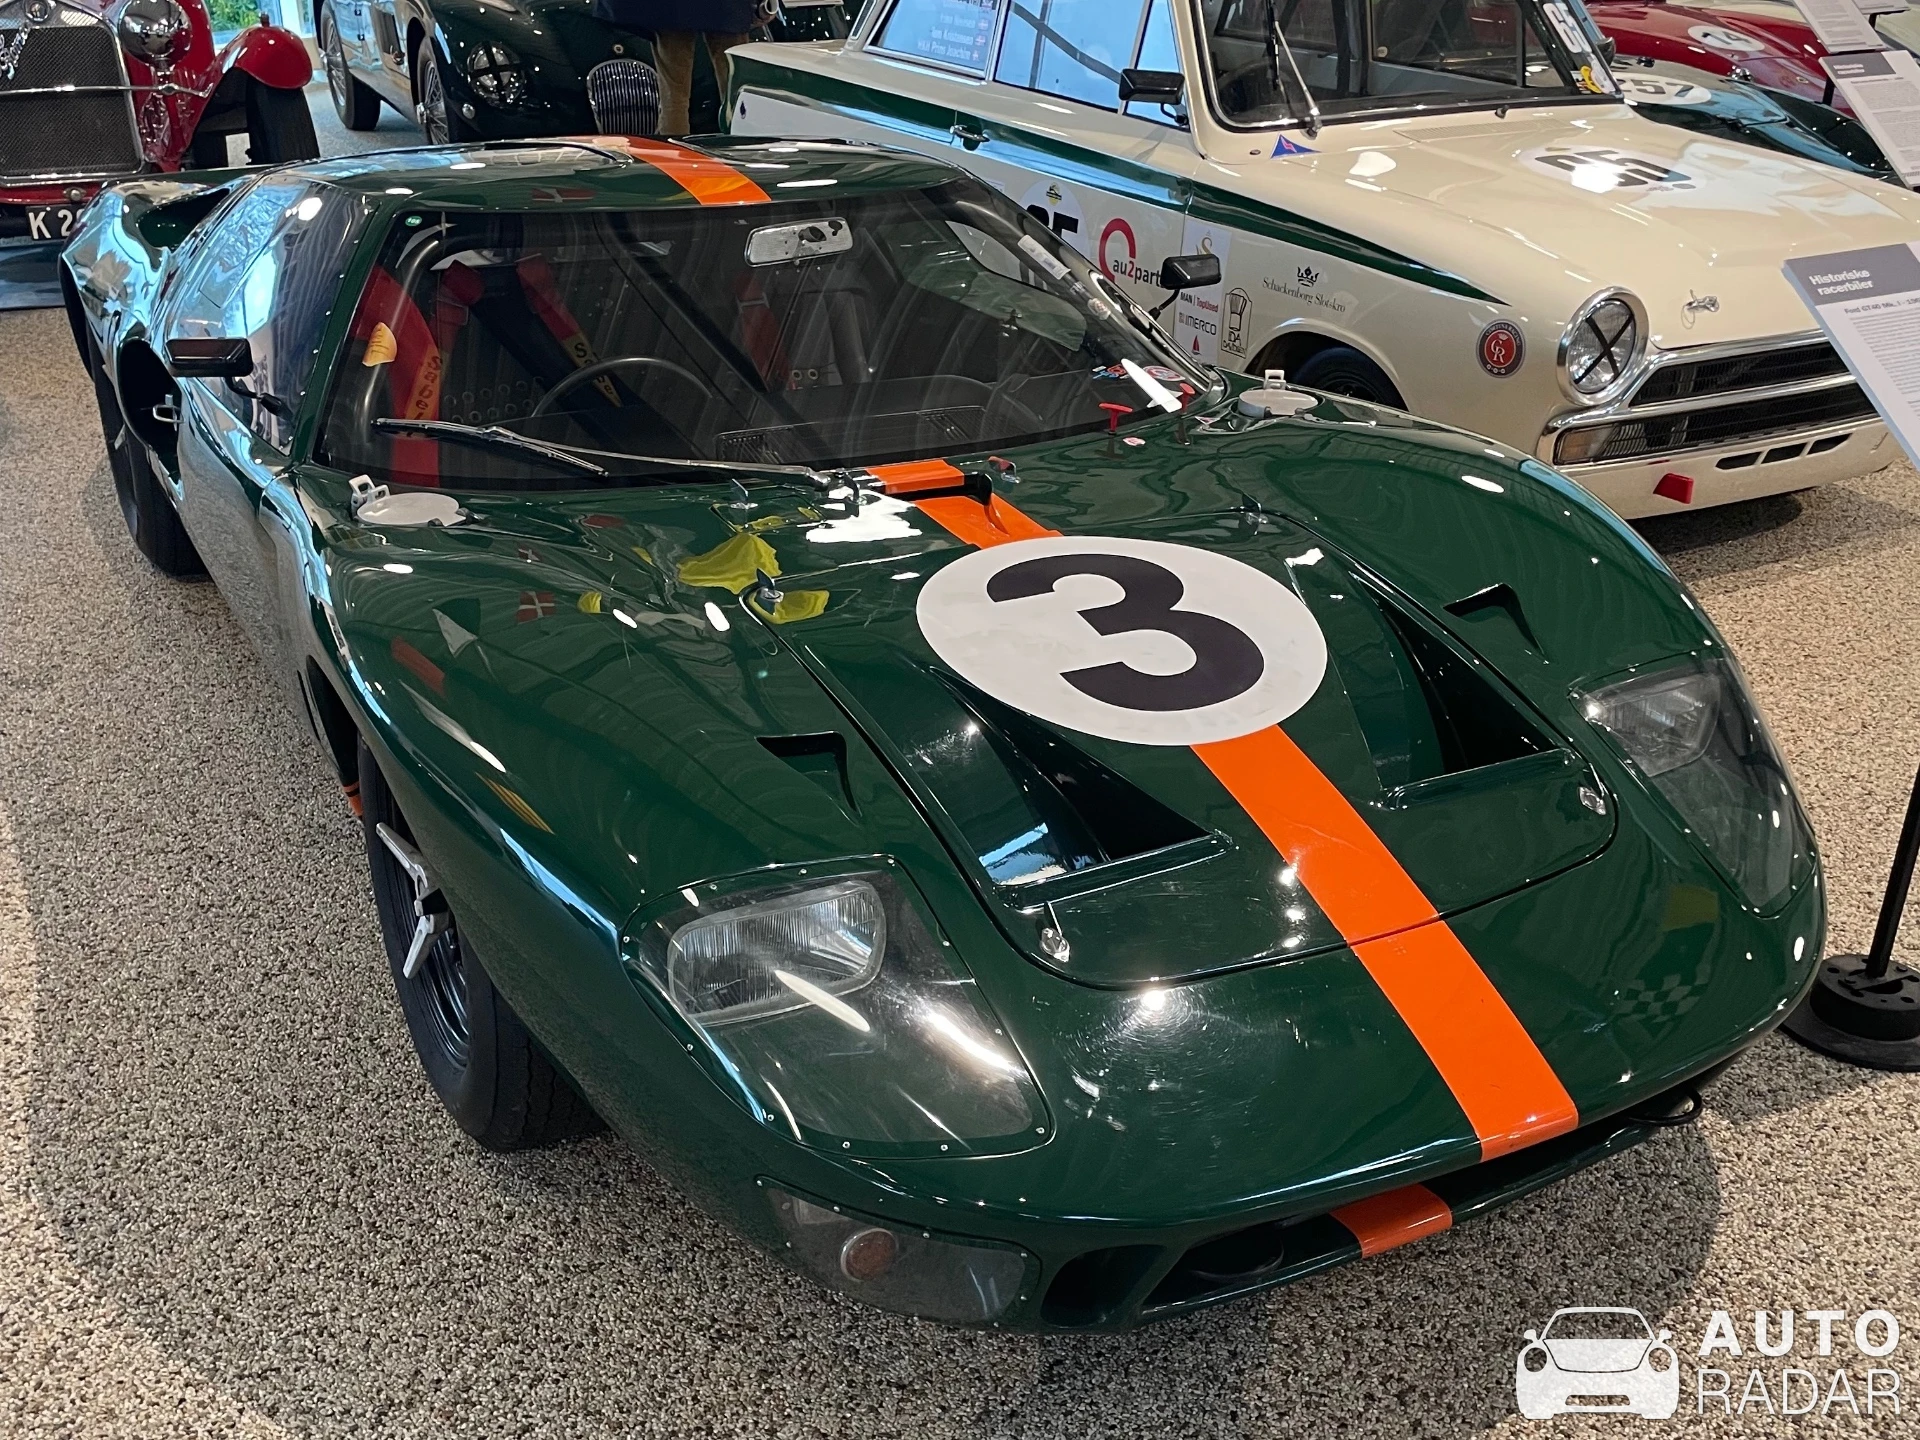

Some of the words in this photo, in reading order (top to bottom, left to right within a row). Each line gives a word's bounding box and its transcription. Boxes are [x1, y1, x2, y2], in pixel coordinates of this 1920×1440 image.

[28, 211, 51, 240] K
[1112, 258, 1163, 288] au2part
[1808, 268, 1870, 285] Historiske
[1262, 276, 1314, 307] Schackenborg
[1817, 279, 1874, 296] racerbiler
[1180, 291, 1193, 304] MAN
[1196, 296, 1219, 313] TopUsed
[1185, 314, 1217, 336] IMERCO
[986, 553, 1265, 712] 3
